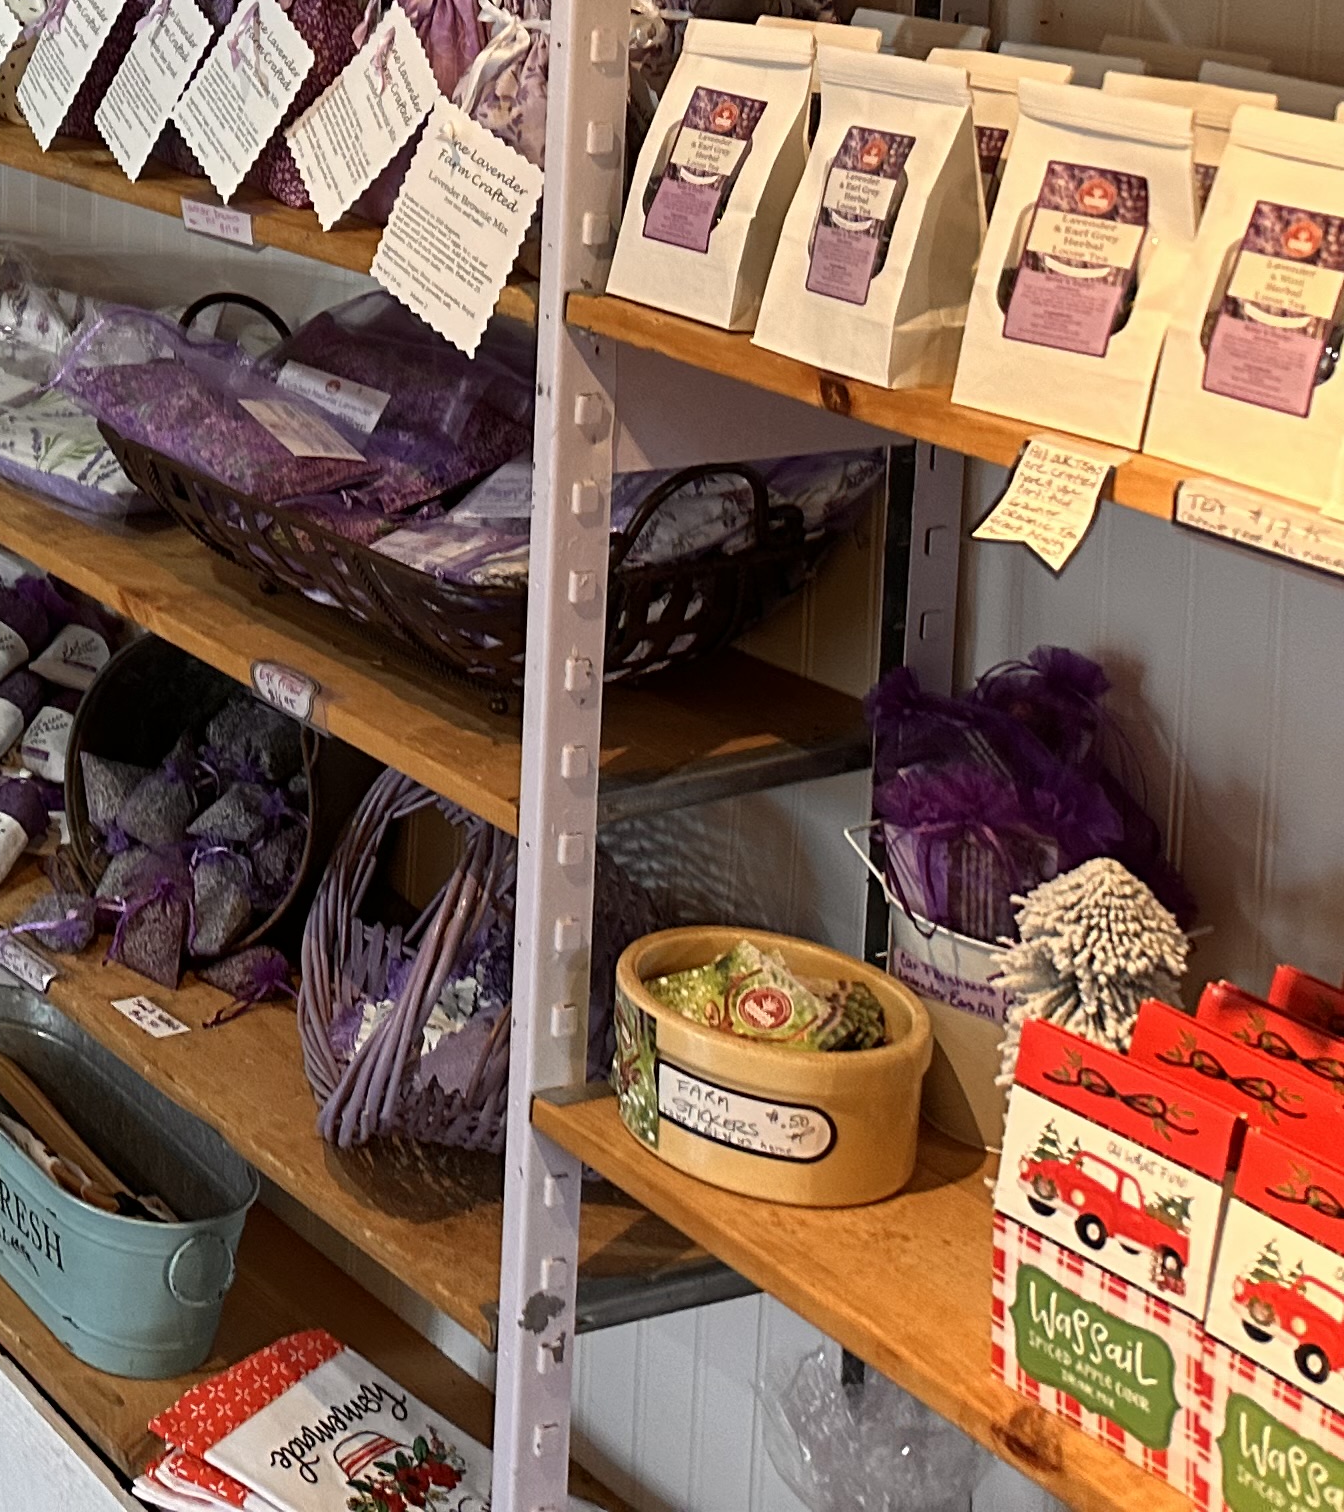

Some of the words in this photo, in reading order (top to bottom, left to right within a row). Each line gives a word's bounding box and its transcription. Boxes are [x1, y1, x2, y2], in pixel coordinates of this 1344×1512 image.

[263, 55, 291, 92] Crafted
[265, 29, 301, 78] Lavender
[397, 61, 423, 113] Lavender
[470, 150, 529, 196] Lavender
[470, 173, 519, 214] Crafted
[427, 169, 461, 200] Lavender
[460, 193, 493, 224] Brownie
[492, 217, 509, 237] Mix
[672, 1097, 759, 1136] STICKERS
[677, 1078, 729, 1113] FARM
[1030, 1280, 1158, 1387] Wassail
